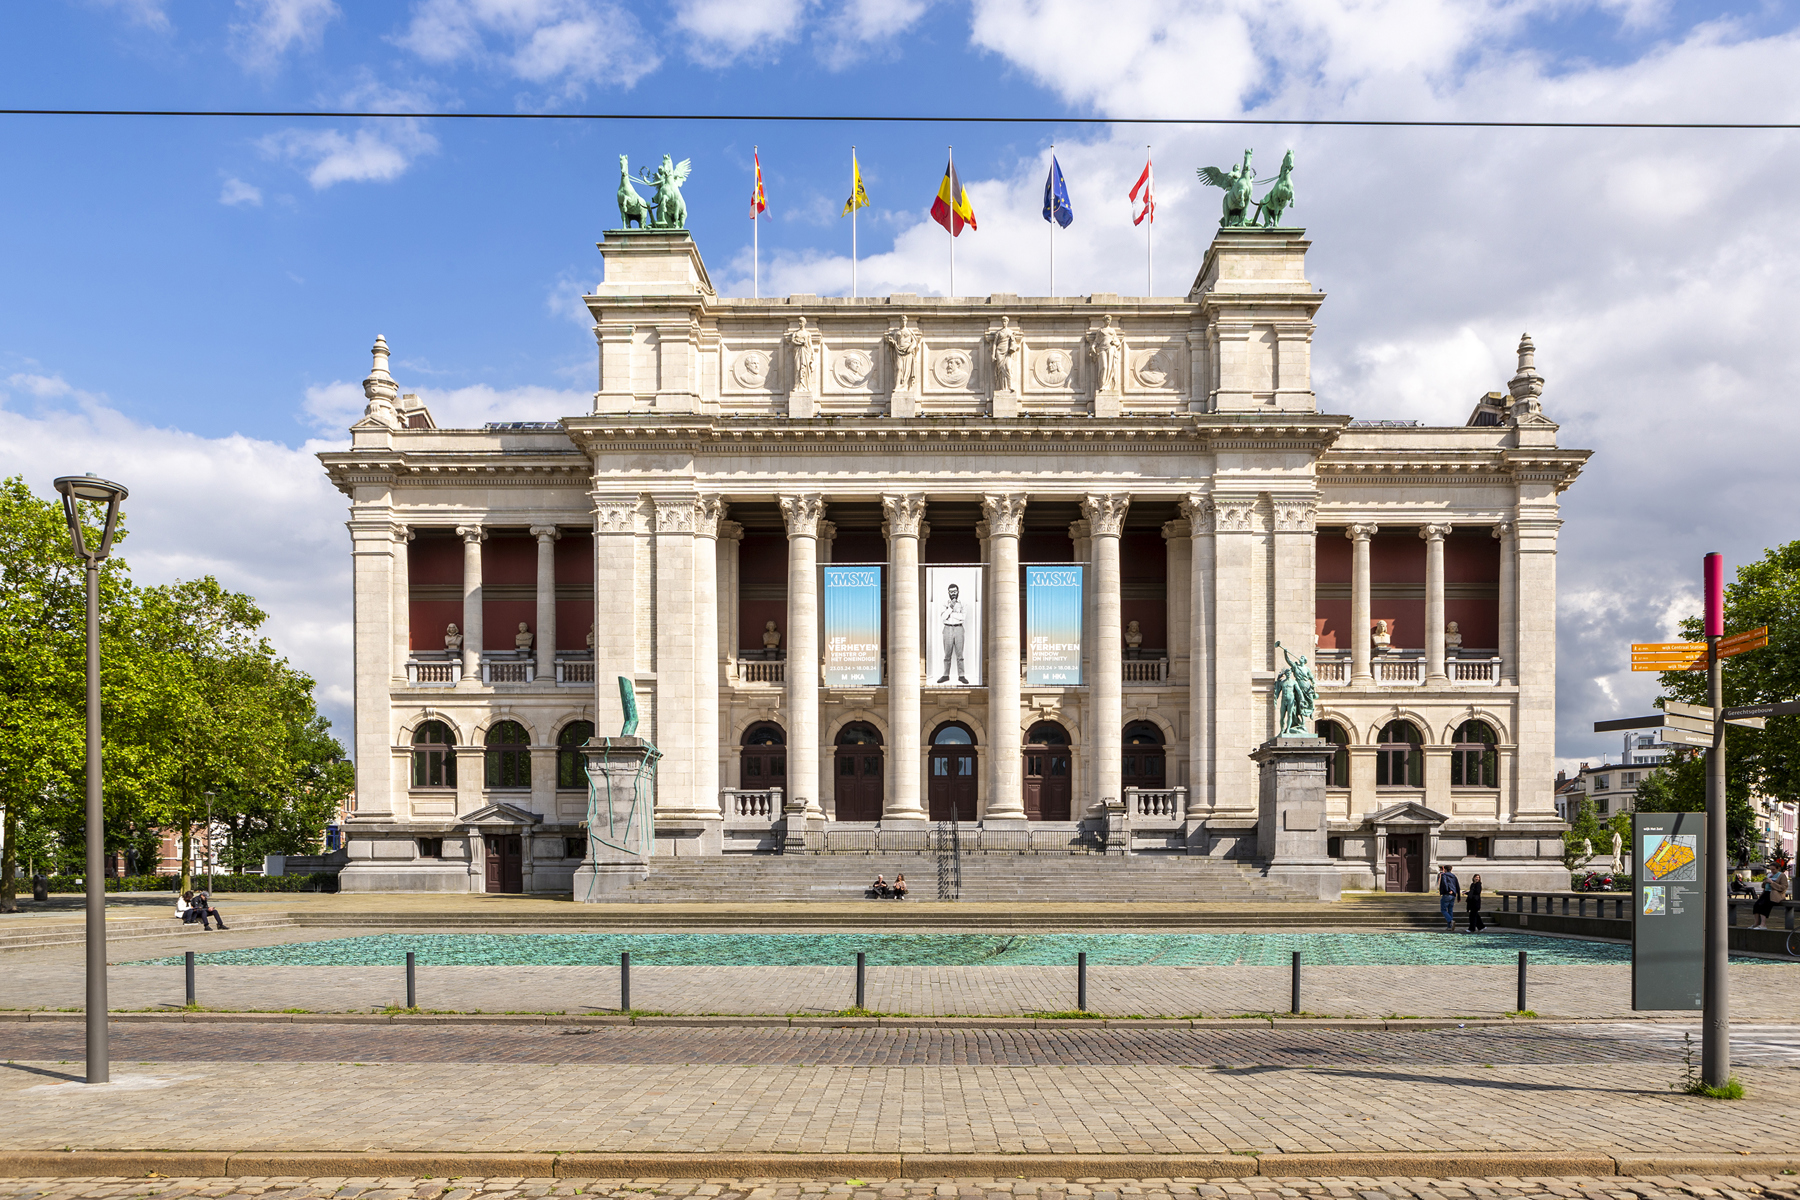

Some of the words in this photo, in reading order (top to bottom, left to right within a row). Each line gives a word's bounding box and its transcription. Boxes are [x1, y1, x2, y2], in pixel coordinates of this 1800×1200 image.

[827, 572, 878, 587] KMSKA
[1029, 571, 1080, 587] KMSKA
[1031, 636, 1048, 644] JEF
[1029, 643, 1080, 651] VERHEYEN
[1727, 707, 1774, 716] Gerechtsgebouw
